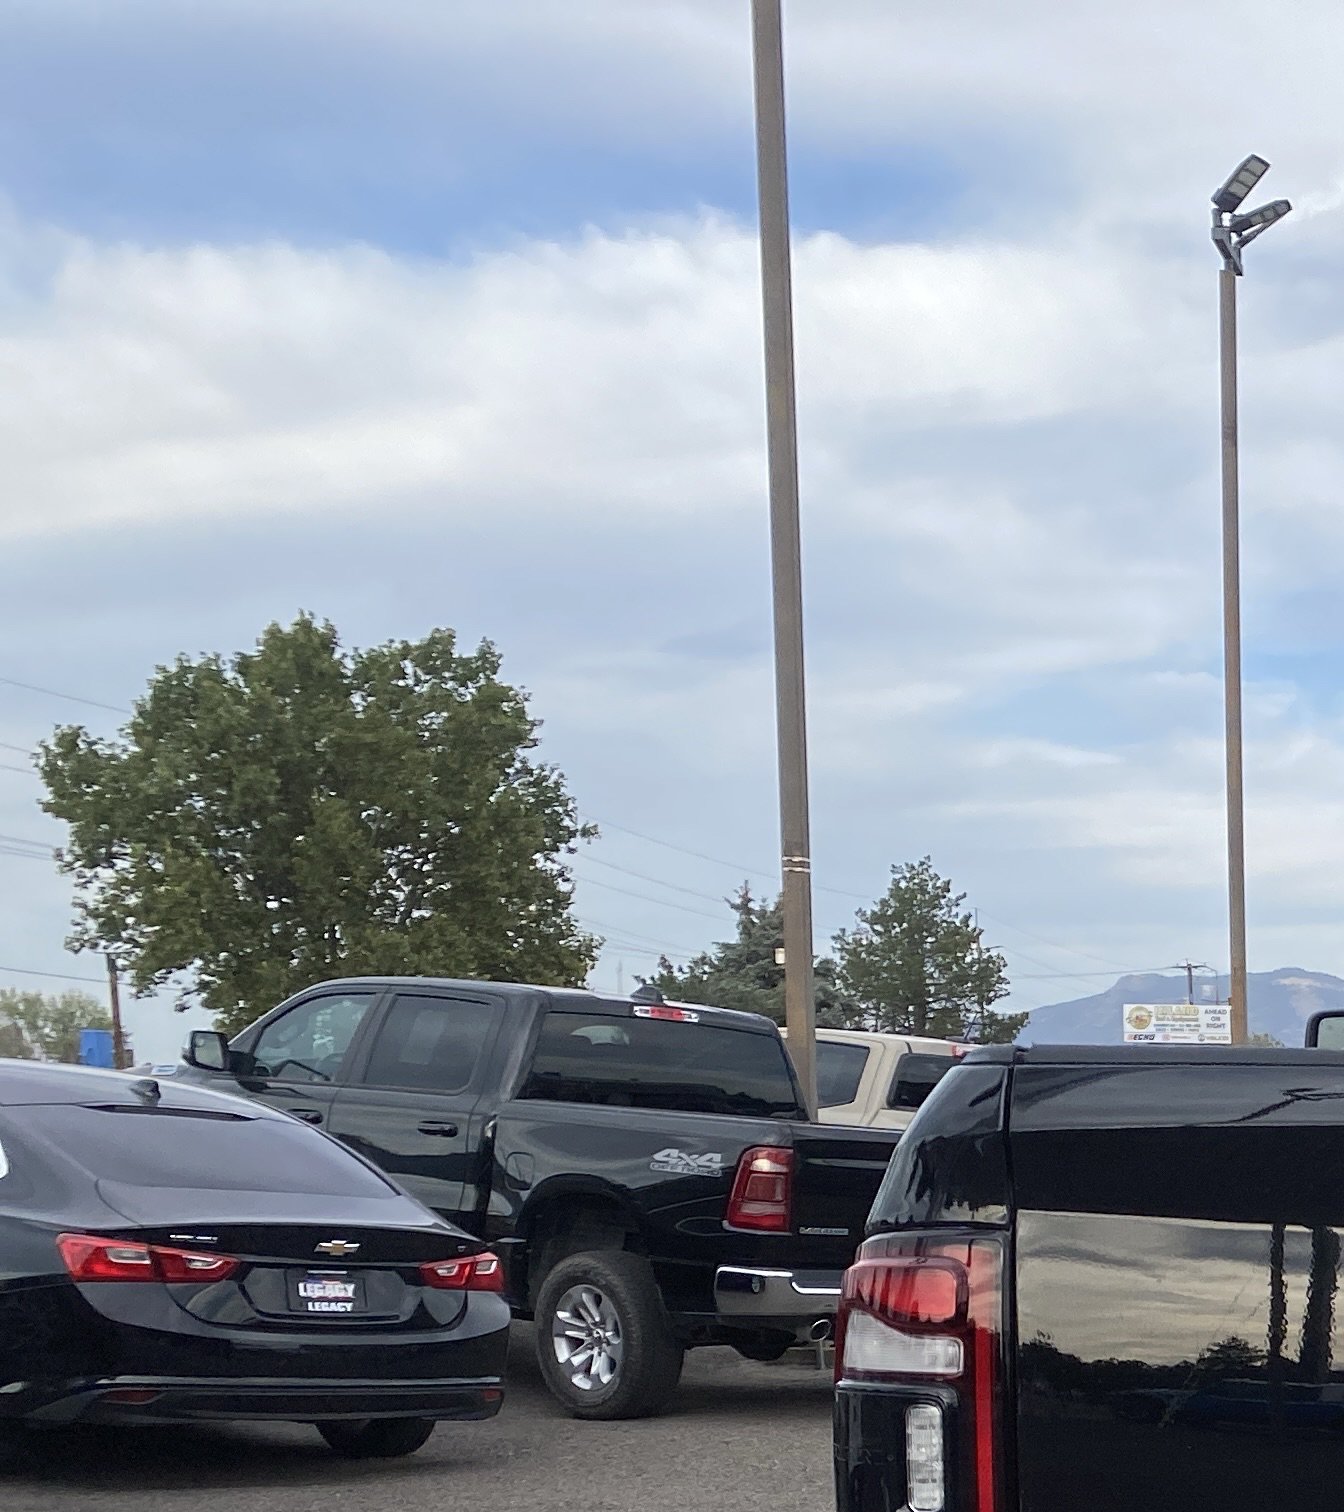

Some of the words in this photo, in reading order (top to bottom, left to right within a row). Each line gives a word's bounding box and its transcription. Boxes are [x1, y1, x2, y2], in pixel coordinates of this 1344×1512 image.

[1133, 1033, 1156, 1041] ECHO
[652, 1148, 725, 1168] 4x4
[298, 1282, 356, 1298] LEGACY
[307, 1302, 354, 1312] LEGACY
